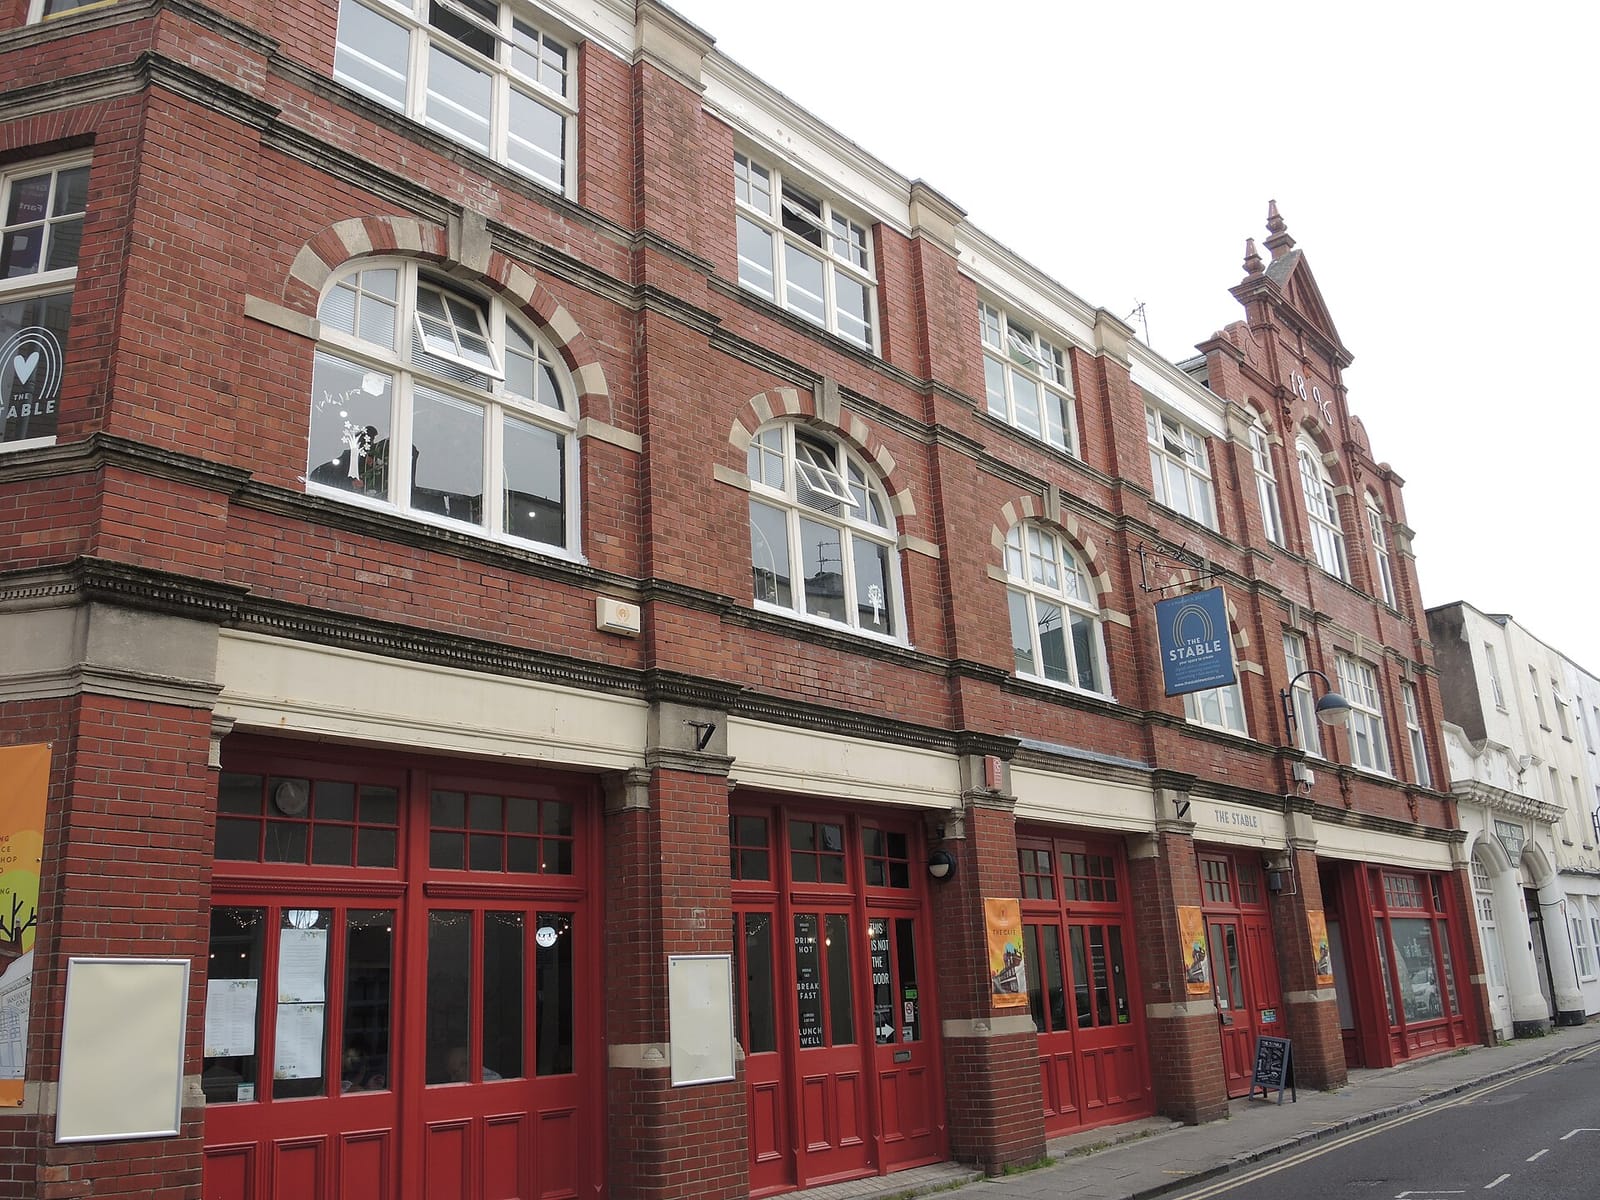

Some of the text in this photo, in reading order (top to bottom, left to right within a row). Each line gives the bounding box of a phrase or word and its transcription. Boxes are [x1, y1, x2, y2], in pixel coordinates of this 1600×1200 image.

[1290, 370, 1333, 425] 1896
[1187, 637, 1201, 646] THE
[1169, 640, 1222, 661] STABLE
[1214, 810, 1258, 828] THE STABLE
[869, 923, 883, 934] THIS
[794, 937, 817, 945] DRINK
[871, 939, 889, 951] IS NOT
[872, 956, 883, 968] THE
[873, 973, 890, 985] DOOR
[797, 982, 820, 991] BREAK
[800, 992, 817, 1000] FAST
[798, 1026, 822, 1035] LUNCH
[801, 1036, 821, 1045] WELL
